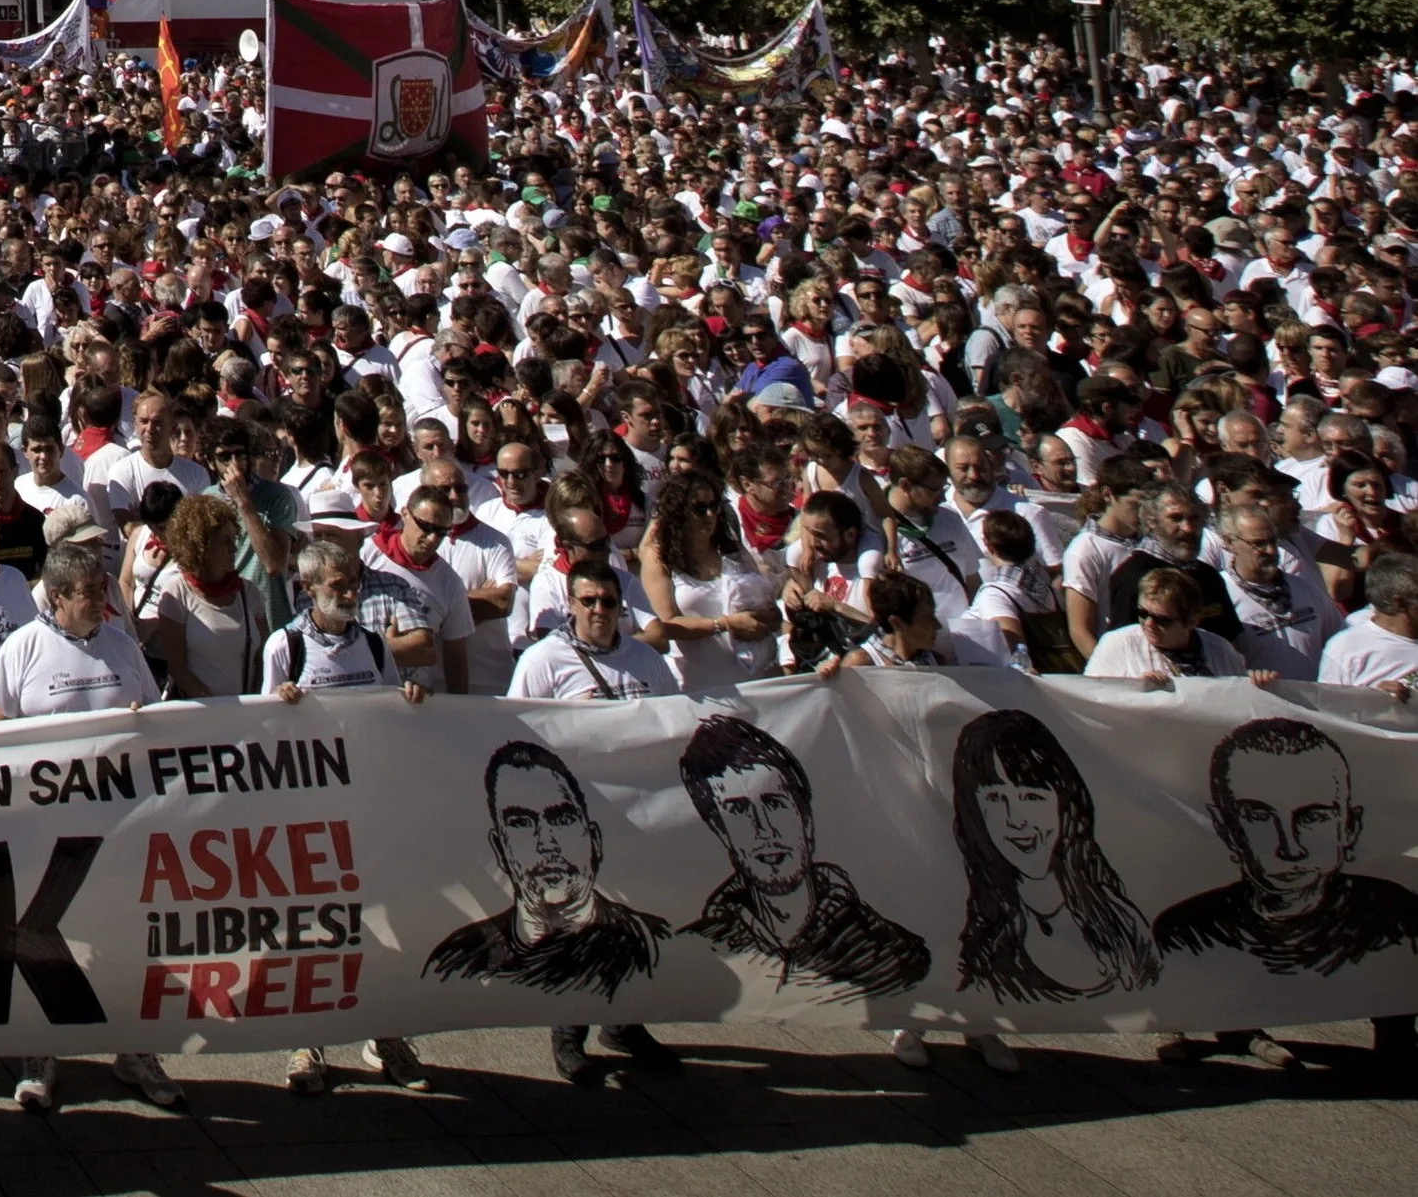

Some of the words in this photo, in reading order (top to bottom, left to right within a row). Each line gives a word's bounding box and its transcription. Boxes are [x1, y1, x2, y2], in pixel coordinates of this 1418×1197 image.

[28, 753, 136, 804] SAN
[148, 738, 351, 796] FERMIN
[140, 820, 361, 904] ASKE!
[139, 952, 364, 1022] FREE!
